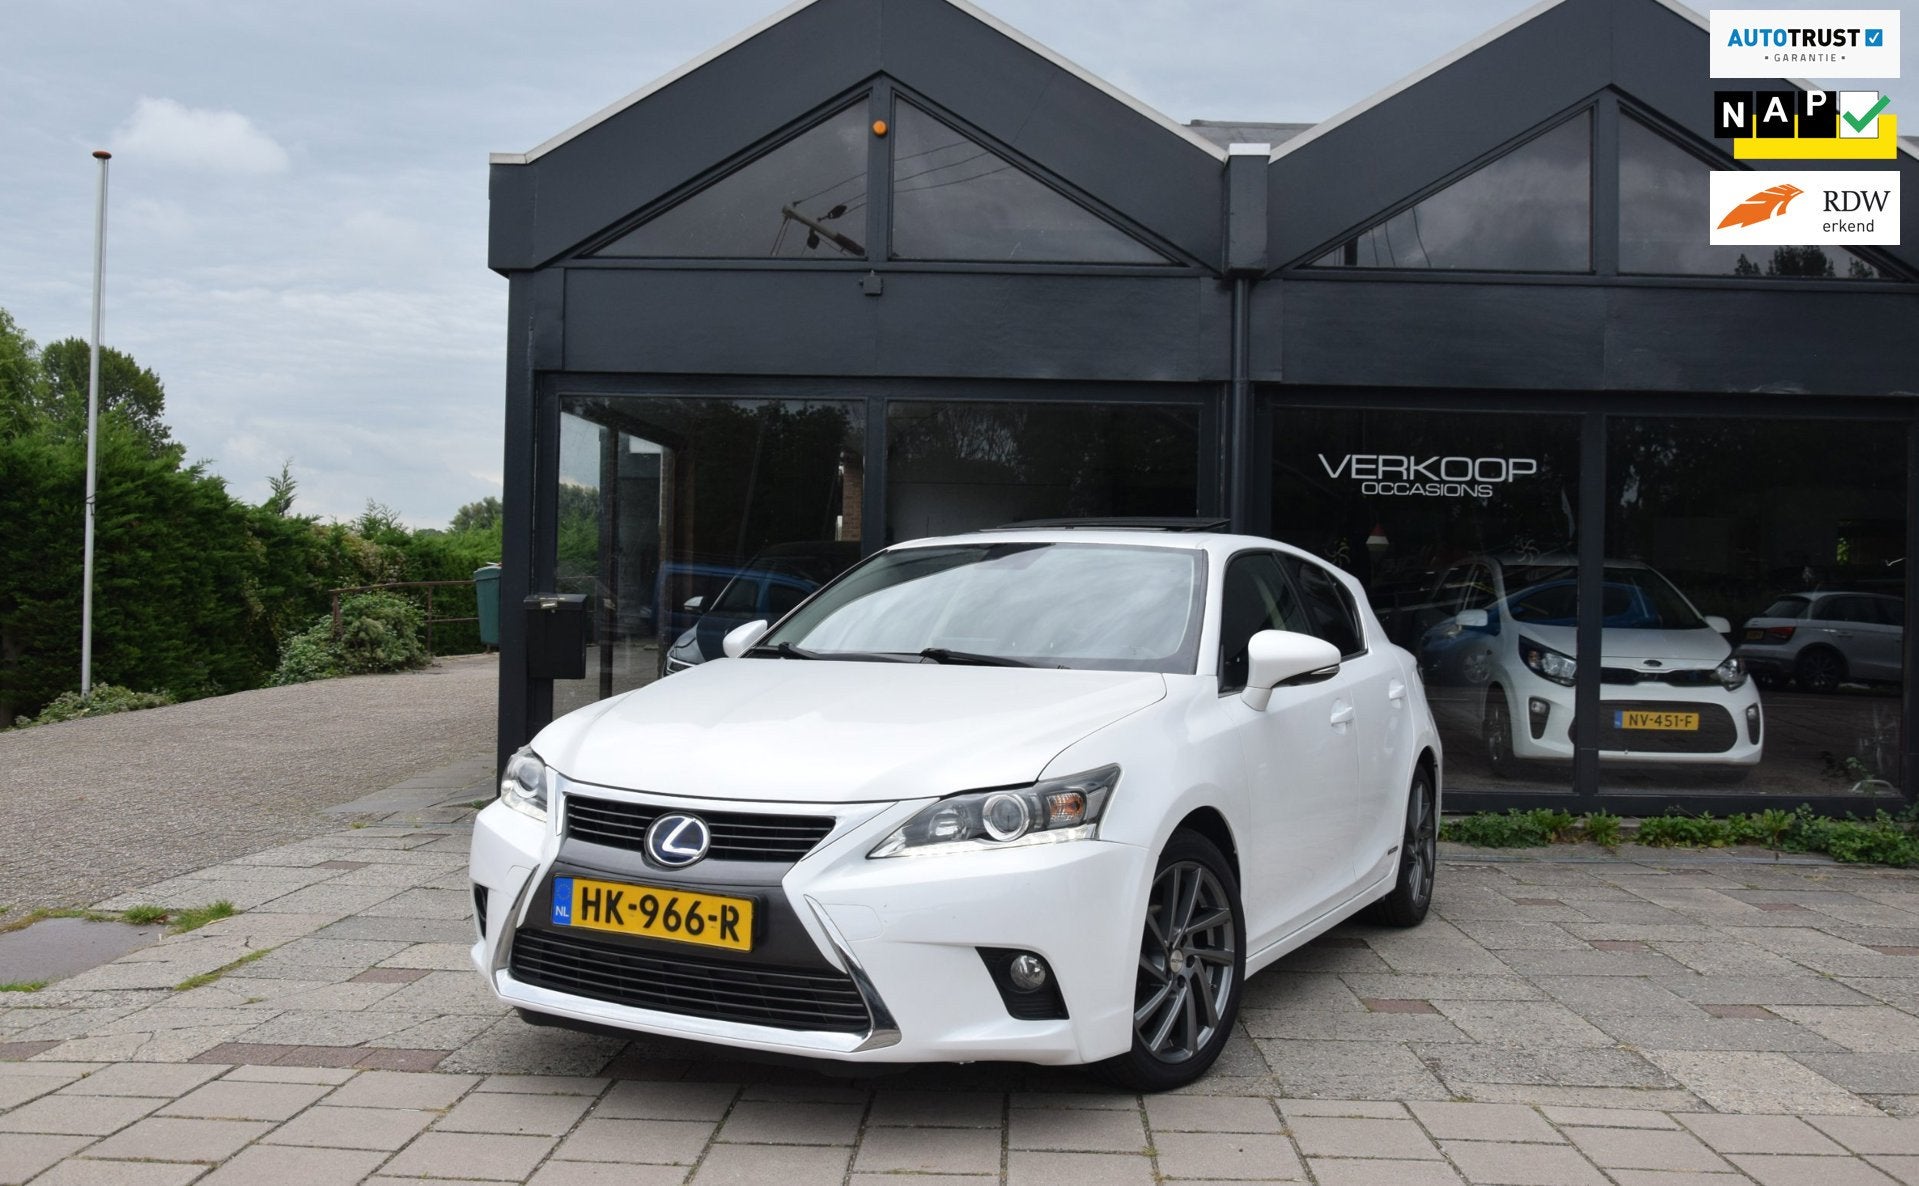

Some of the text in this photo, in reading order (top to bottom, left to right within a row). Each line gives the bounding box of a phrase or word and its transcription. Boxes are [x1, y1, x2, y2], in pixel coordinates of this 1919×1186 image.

[1317, 453, 1538, 483] VERKOOP
[1361, 481, 1493, 498] OCCASIONS
[1628, 713, 1693, 728] NV-451-F
[555, 886, 740, 943] NL HK-966-R
